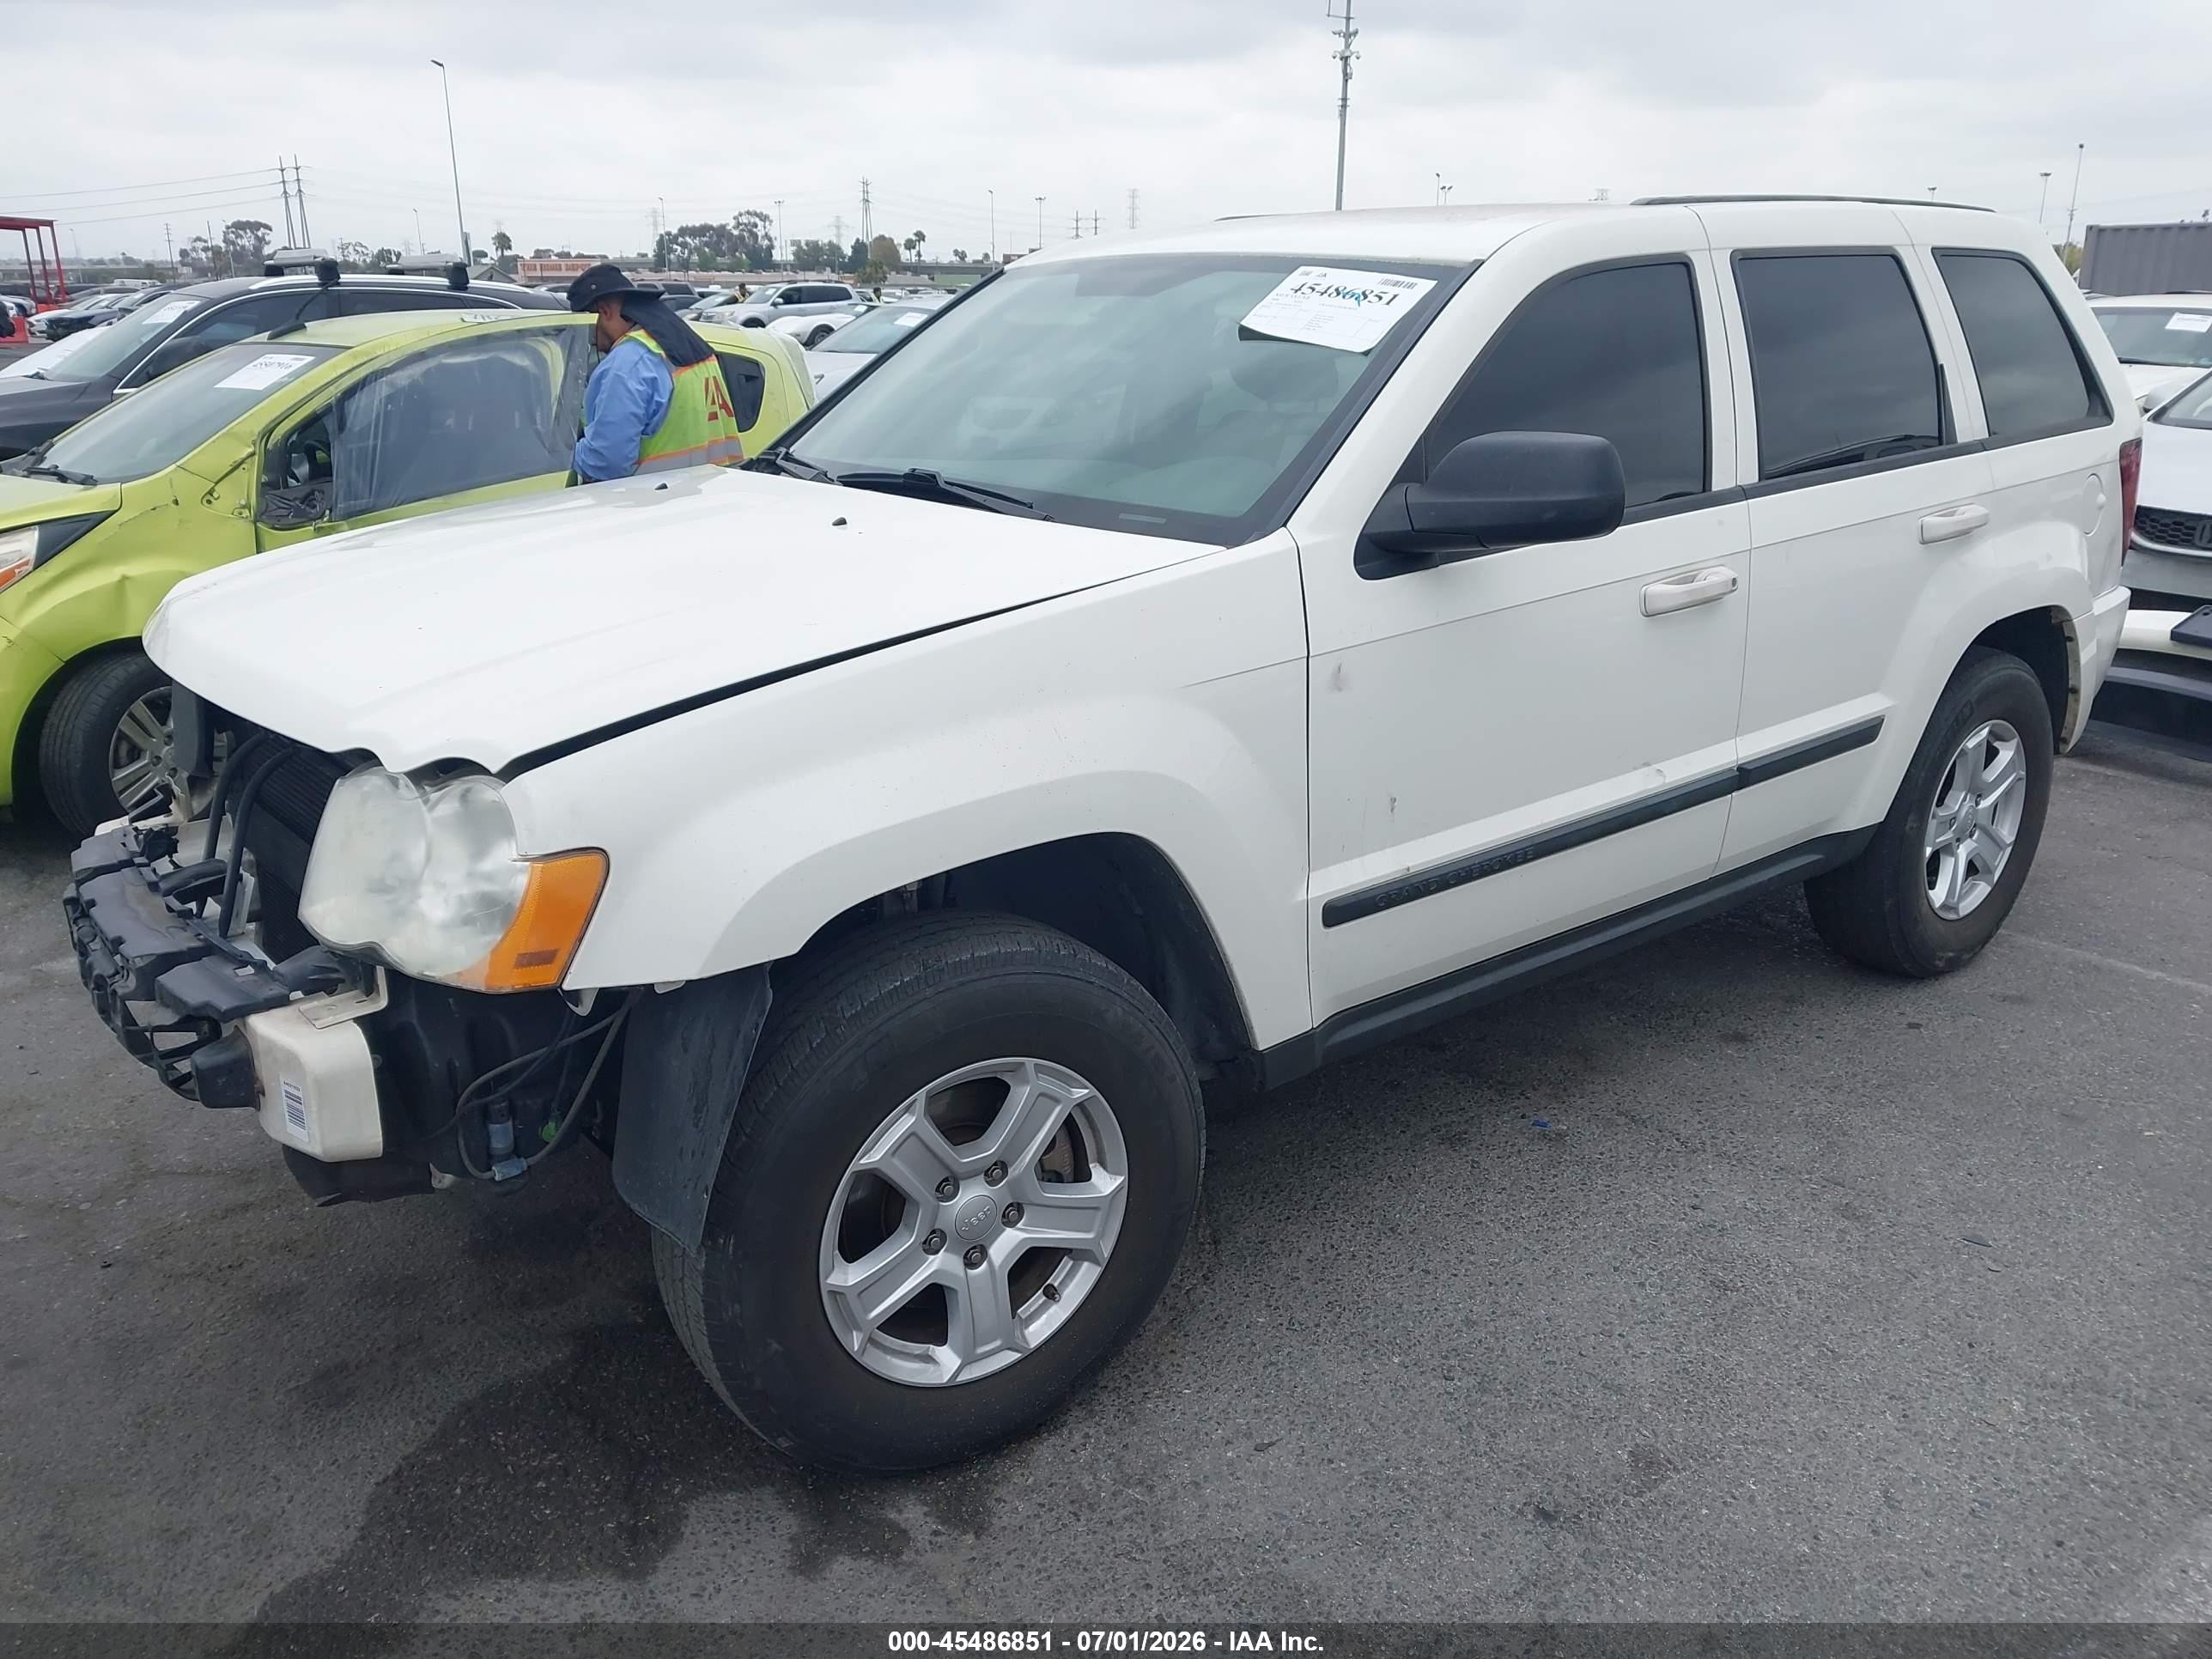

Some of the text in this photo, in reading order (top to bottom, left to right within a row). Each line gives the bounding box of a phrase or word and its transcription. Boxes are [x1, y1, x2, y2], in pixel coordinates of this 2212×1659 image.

[1290, 282, 1400, 307] 45486851
[1376, 847, 1534, 907] GRAND CHEROKEE
[961, 1206, 991, 1231] Jeep
